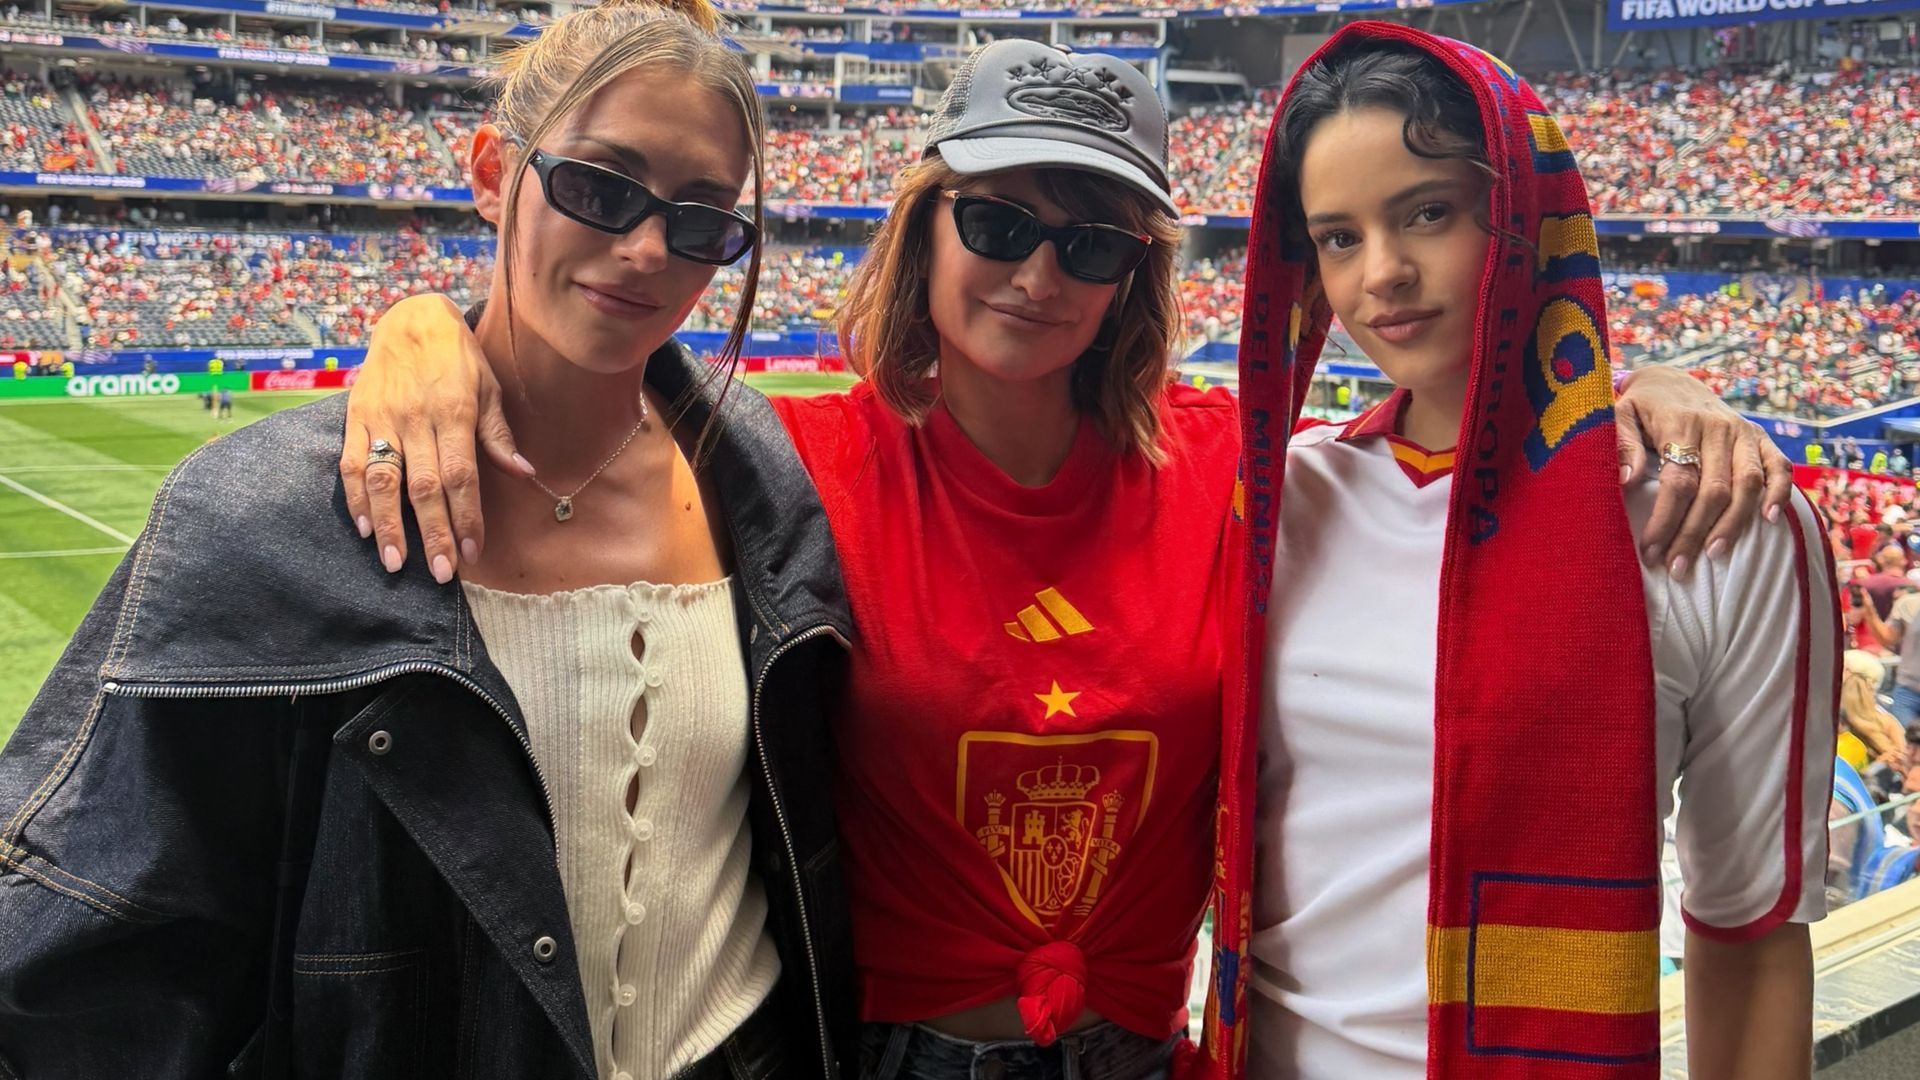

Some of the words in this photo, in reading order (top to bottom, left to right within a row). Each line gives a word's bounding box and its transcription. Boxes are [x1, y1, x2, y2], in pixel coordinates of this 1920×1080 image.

[1621, 0, 1676, 20] FIFA
[1677, 0, 1765, 17] WORLD
[1250, 293, 1270, 384] DEL
[765, 357, 819, 371] Lenovo
[66, 373, 180, 396] aramco
[1470, 307, 1518, 546] EUROPA
